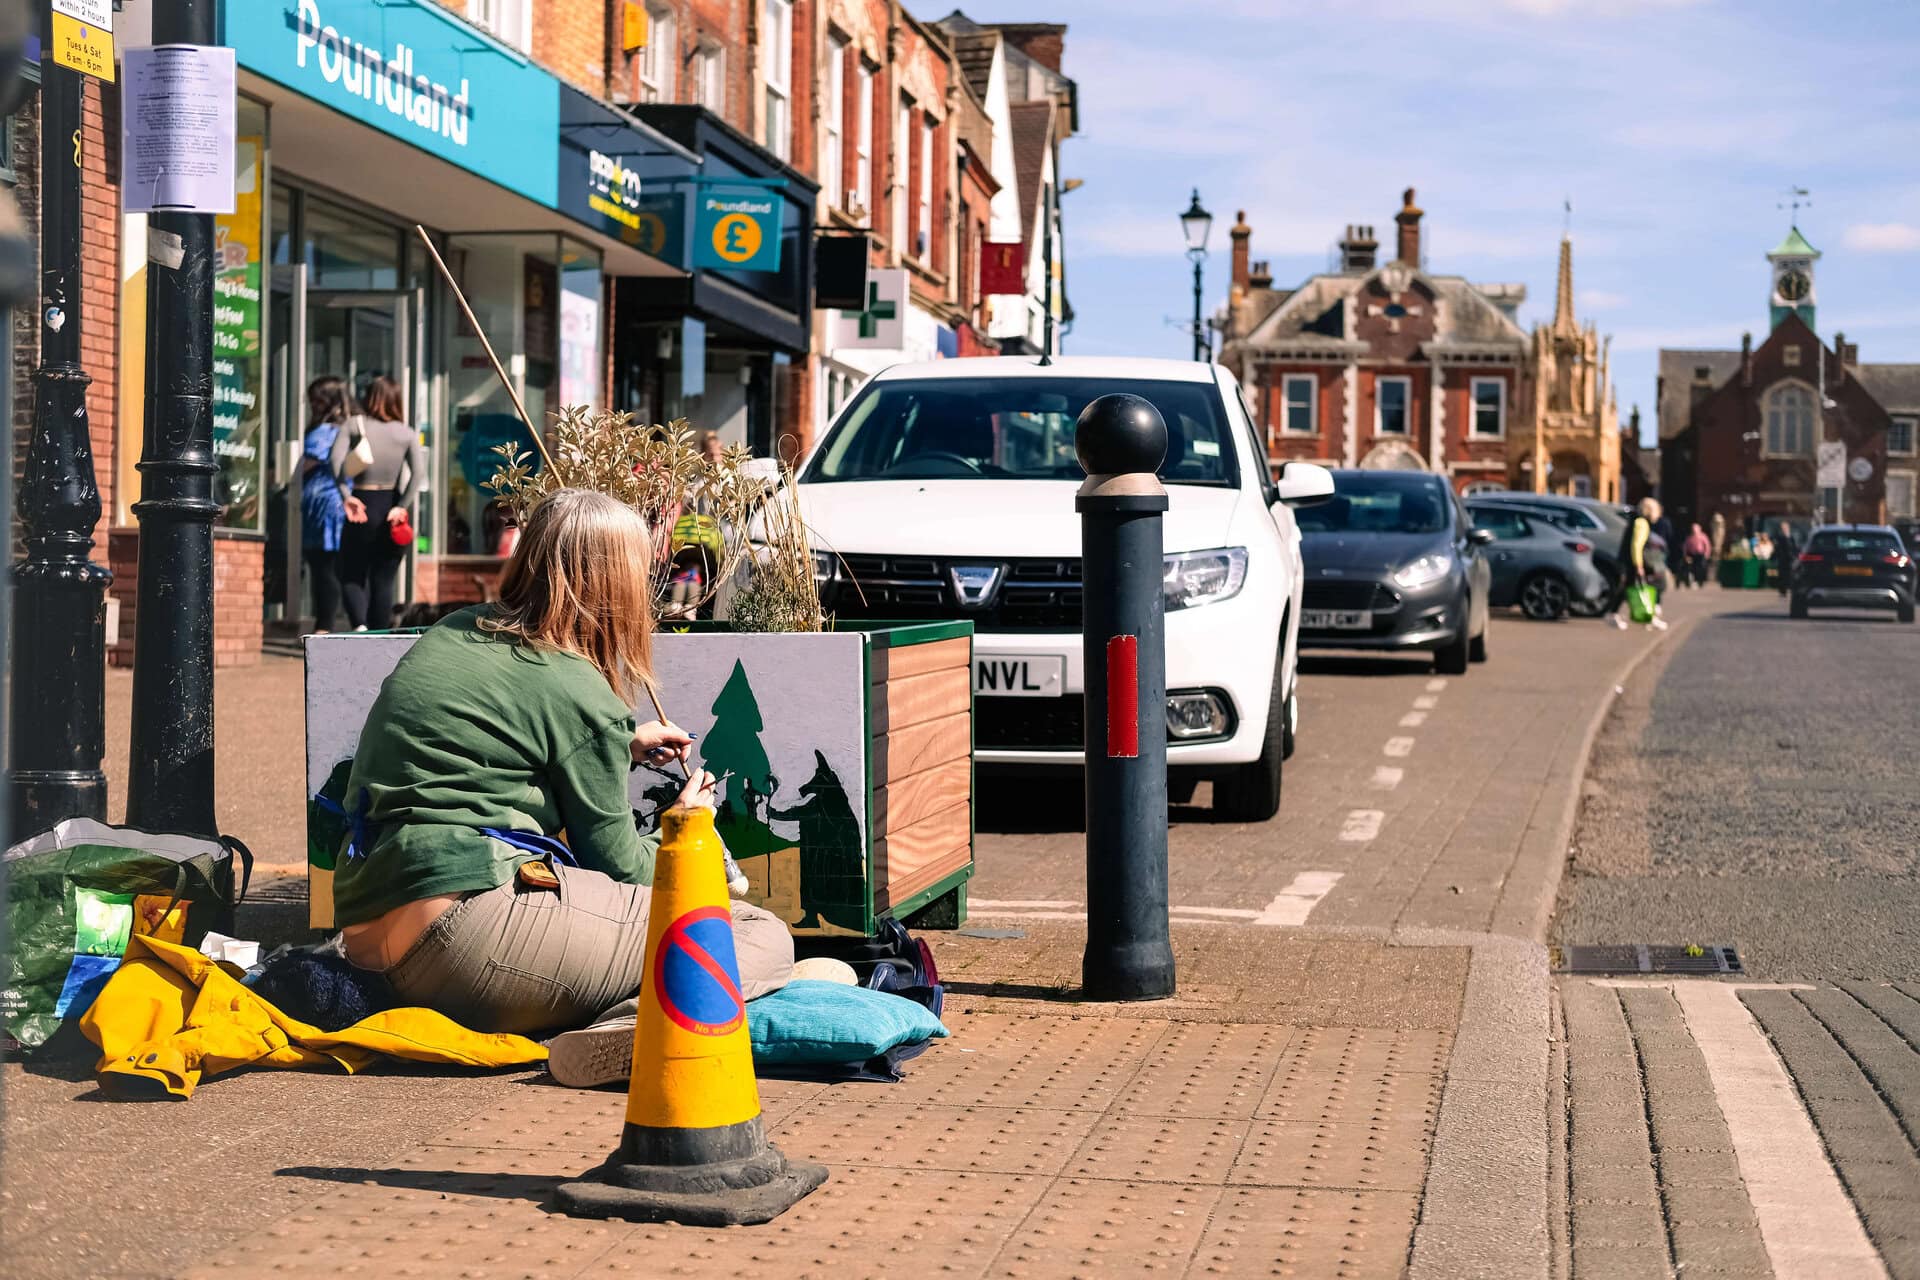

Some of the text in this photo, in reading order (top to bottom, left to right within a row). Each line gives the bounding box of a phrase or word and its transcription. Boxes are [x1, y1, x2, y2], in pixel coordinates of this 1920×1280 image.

[60, 0, 105, 24] within 2 hours
[66, 37, 102, 59] Tues & Sat
[297, 0, 469, 146] Poundland
[706, 199, 772, 215] Poundland
[978, 661, 1040, 690] NVL
[695, 1020, 739, 1035] No waiting
